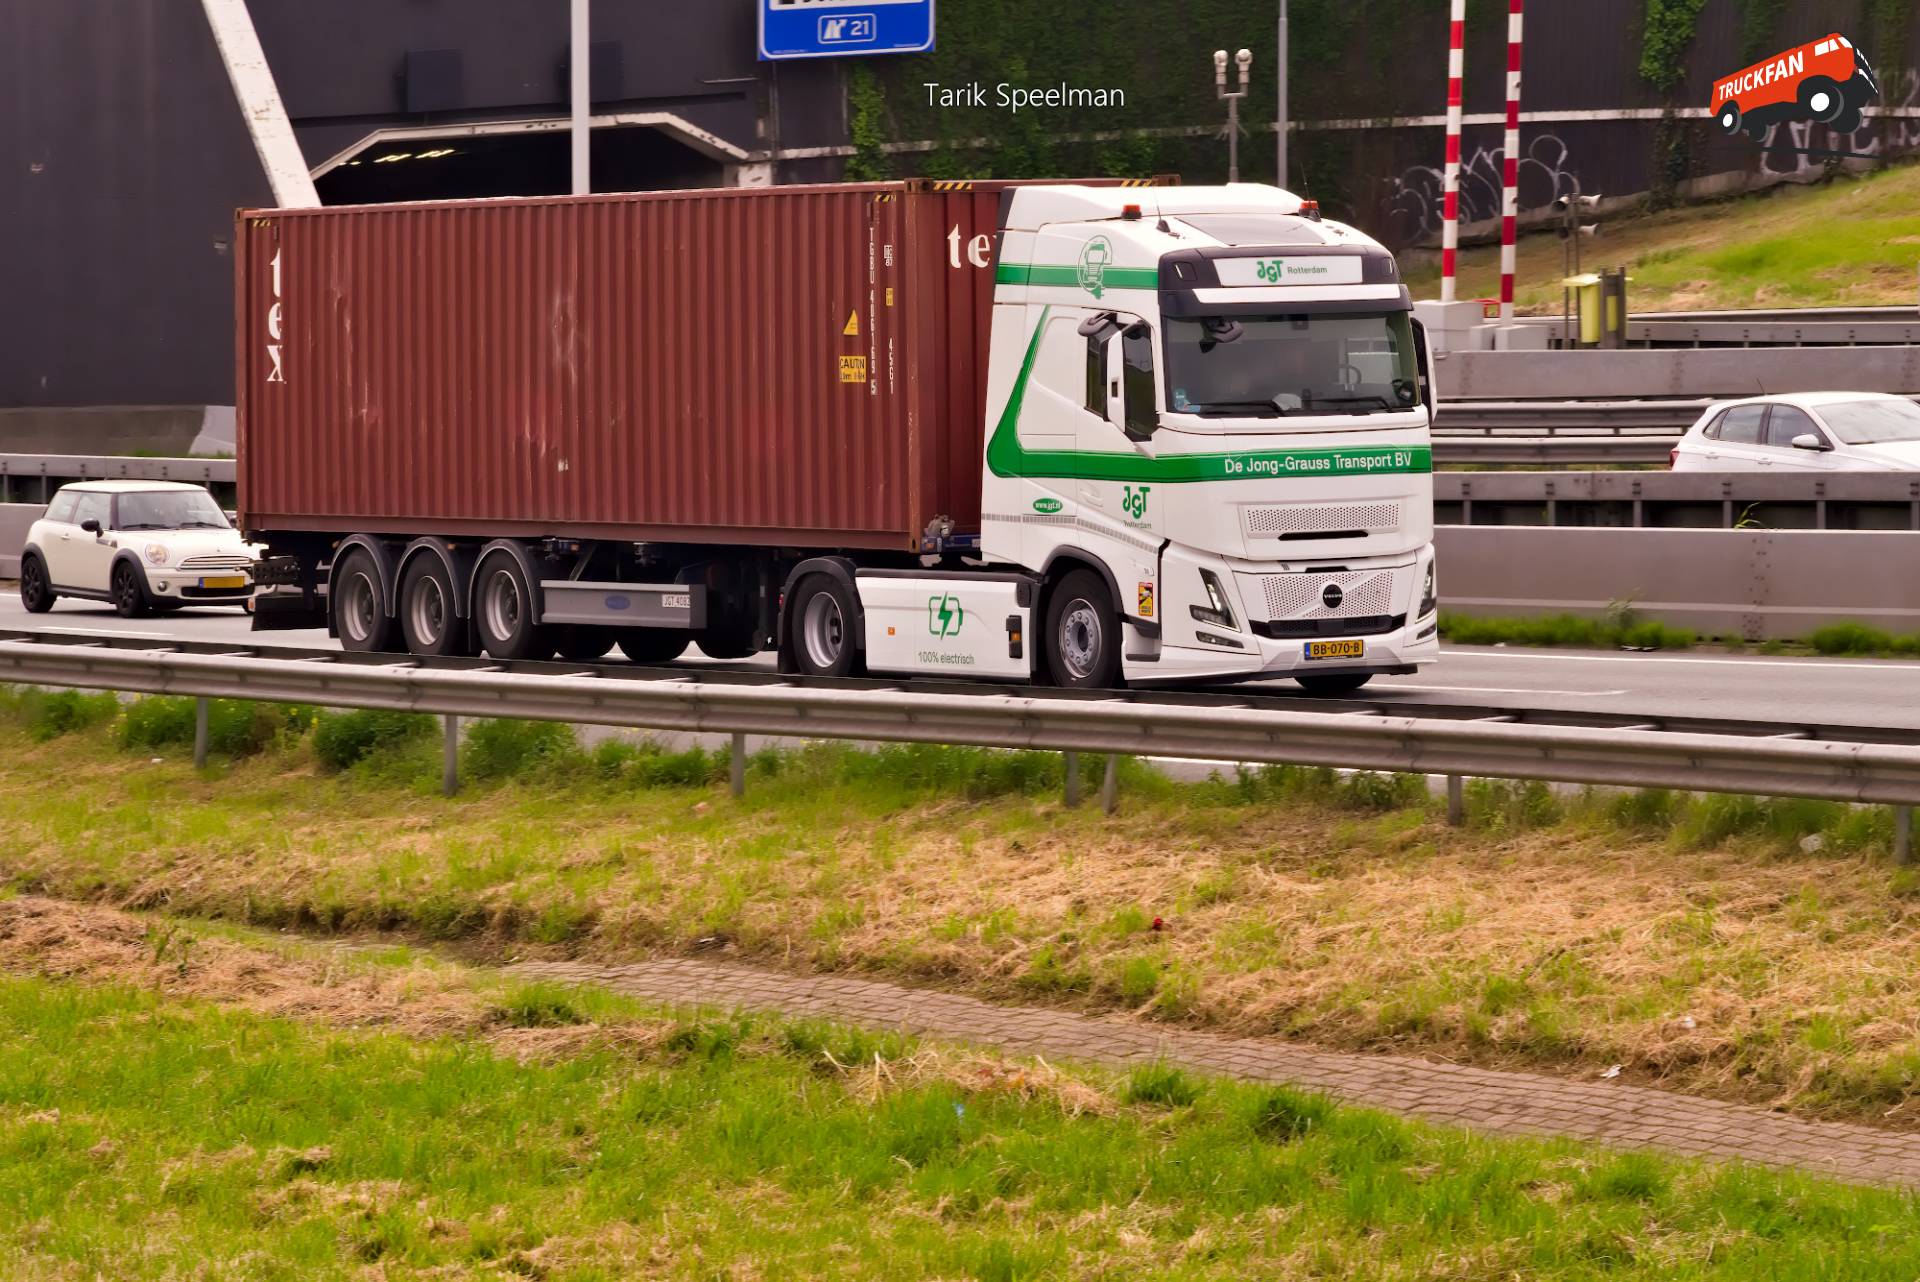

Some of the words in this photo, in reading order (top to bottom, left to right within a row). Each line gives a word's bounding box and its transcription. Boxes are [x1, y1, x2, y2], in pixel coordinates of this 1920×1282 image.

[851, 20, 869, 36] 21
[947, 223, 997, 268] te
[1287, 266, 1328, 274] Rotterdam
[1224, 459, 1243, 473] De
[1246, 456, 1330, 475] Jong-Grauss
[1333, 454, 1392, 471] Transport
[1394, 451, 1412, 467] BV
[918, 651, 939, 663] 100%
[940, 652, 974, 665] electrisch
